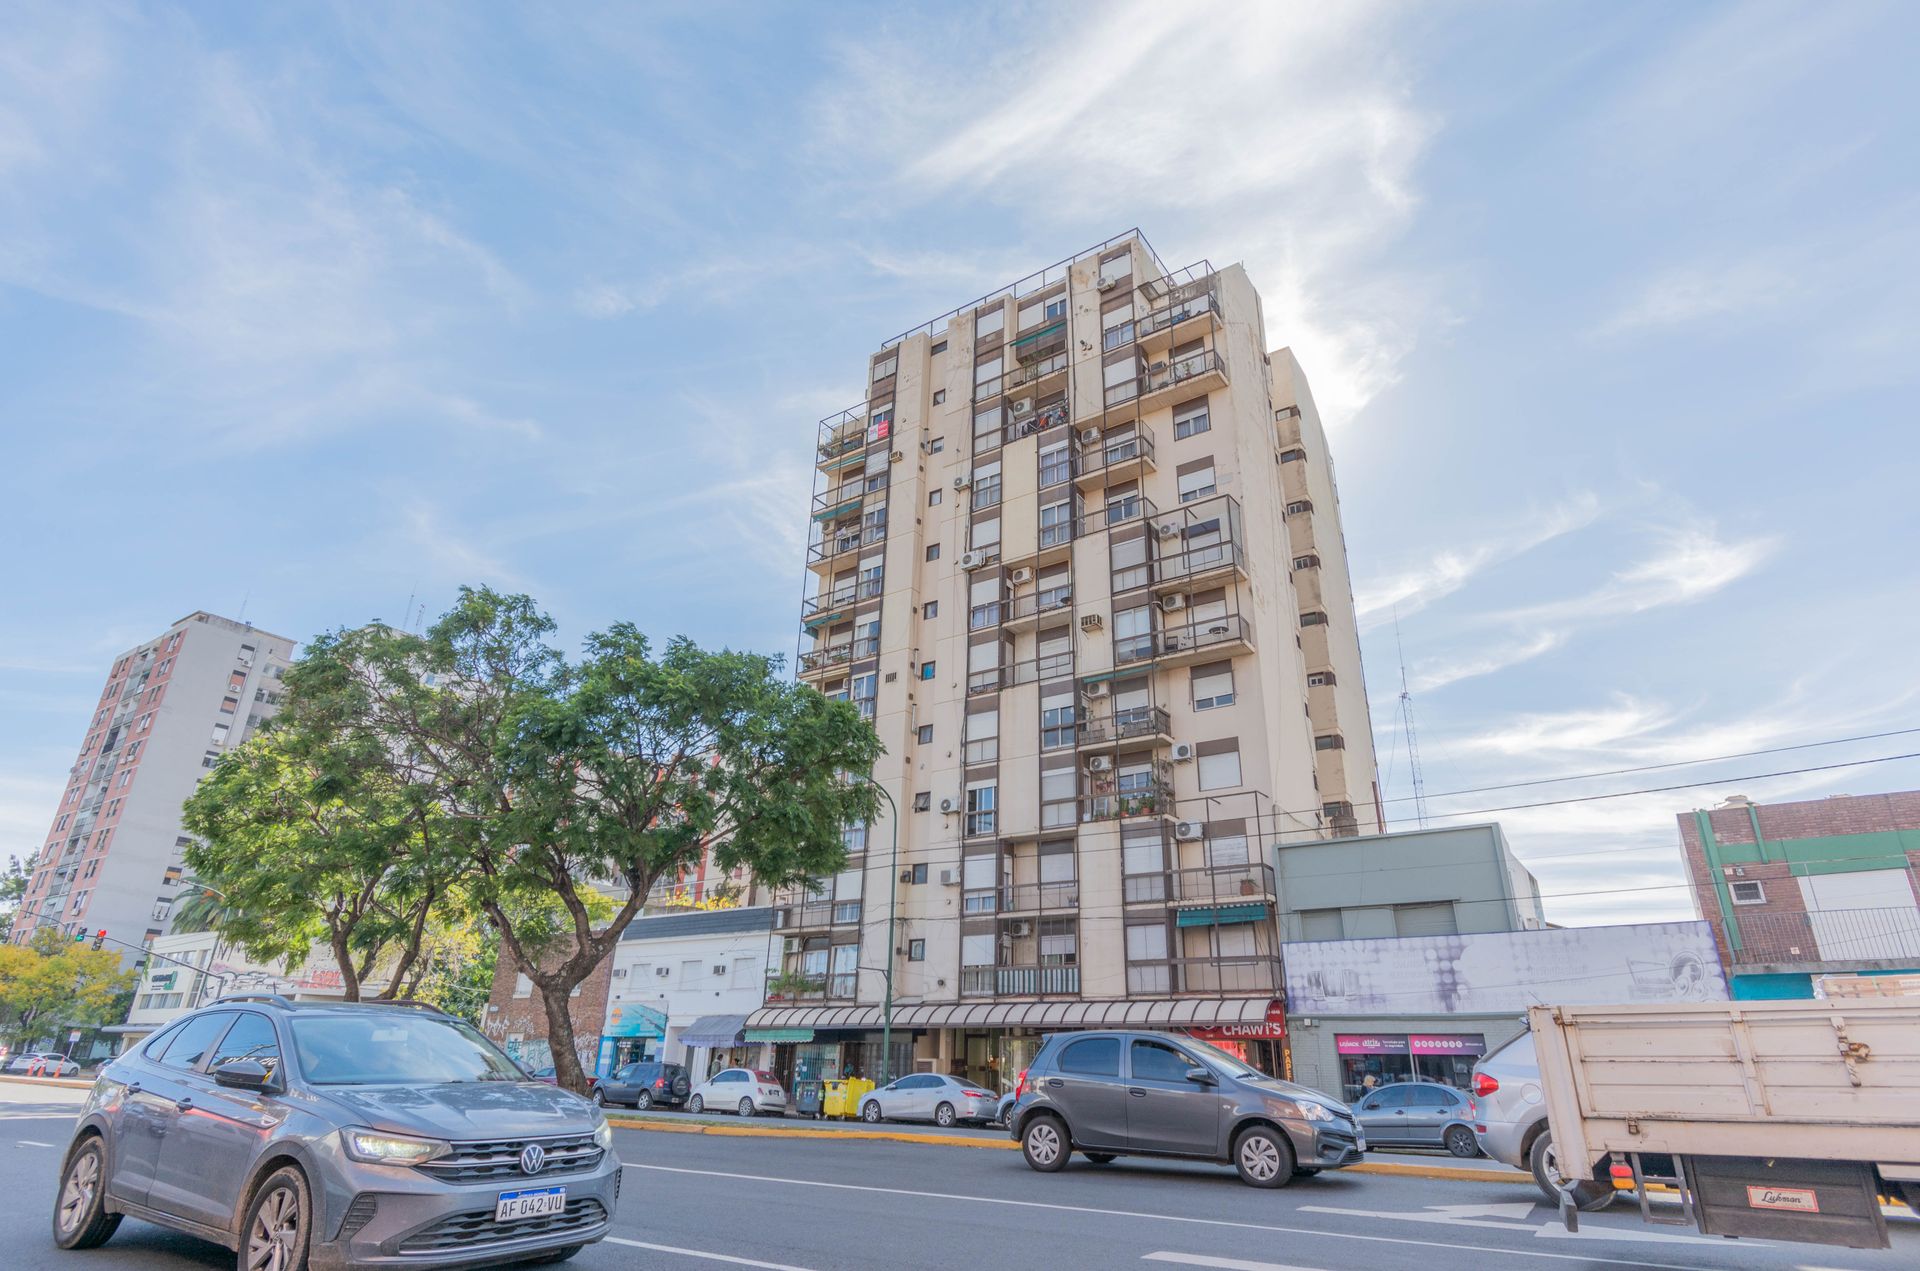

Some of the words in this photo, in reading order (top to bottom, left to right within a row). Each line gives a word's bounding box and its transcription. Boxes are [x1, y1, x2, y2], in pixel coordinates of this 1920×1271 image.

[500, 1201, 516, 1218] AF
[520, 1198, 544, 1215] 042
[548, 1195, 563, 1211] VU
